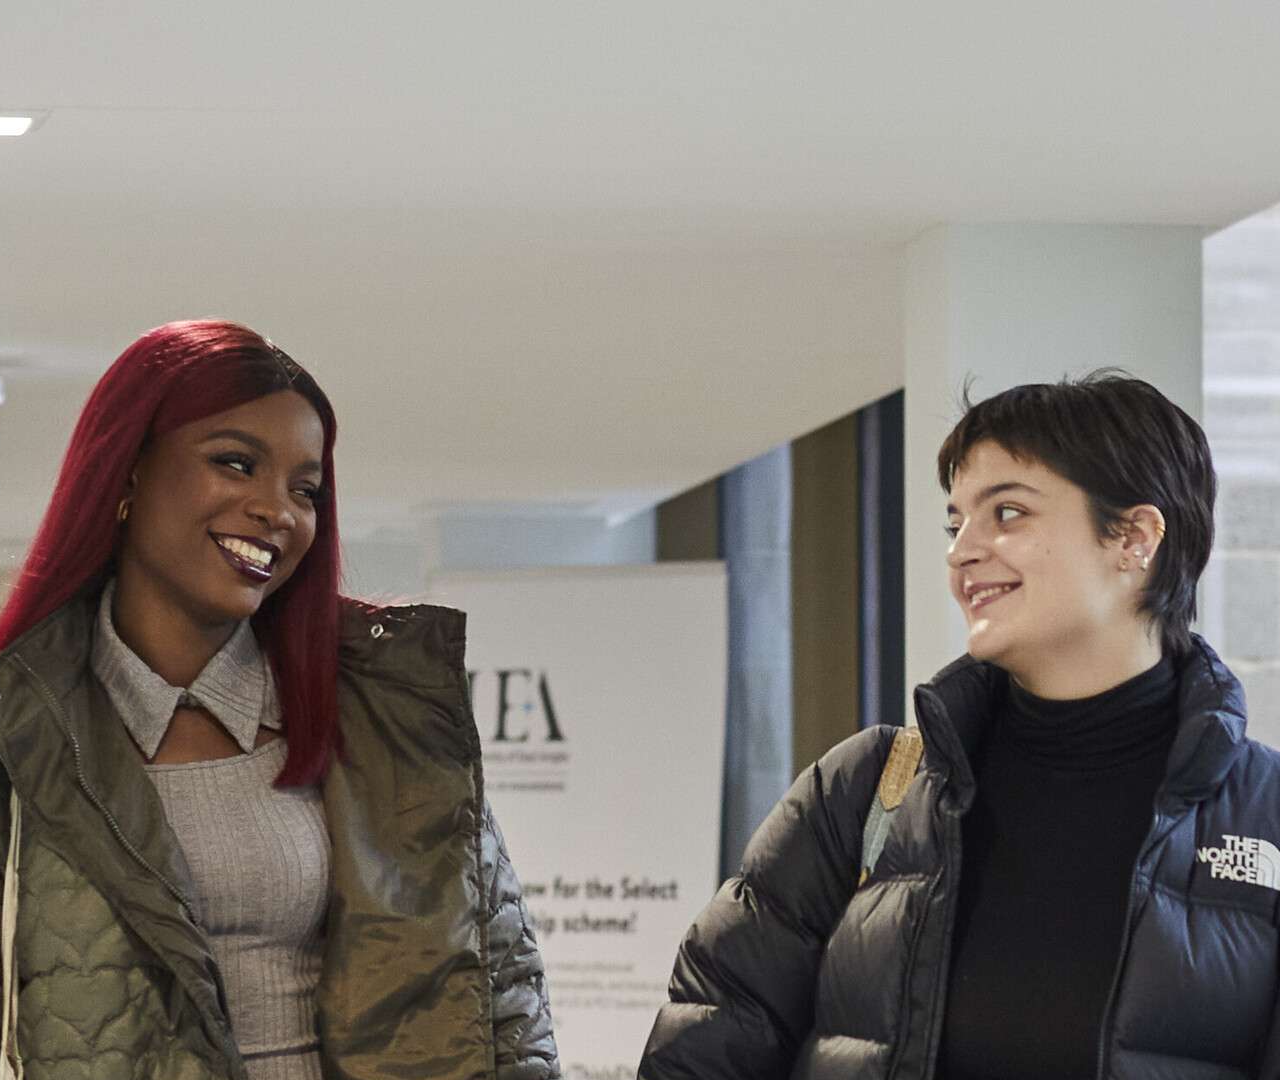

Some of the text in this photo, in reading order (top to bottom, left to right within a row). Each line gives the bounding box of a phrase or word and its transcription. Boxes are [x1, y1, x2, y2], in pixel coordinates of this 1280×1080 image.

[1222, 834, 1259, 851] THE
[1196, 846, 1258, 868] NORTH
[1211, 863, 1258, 884] FACE
[552, 876, 580, 898] for
[585, 876, 614, 898] the
[620, 875, 679, 899] Select
[562, 909, 639, 934] scheme!
